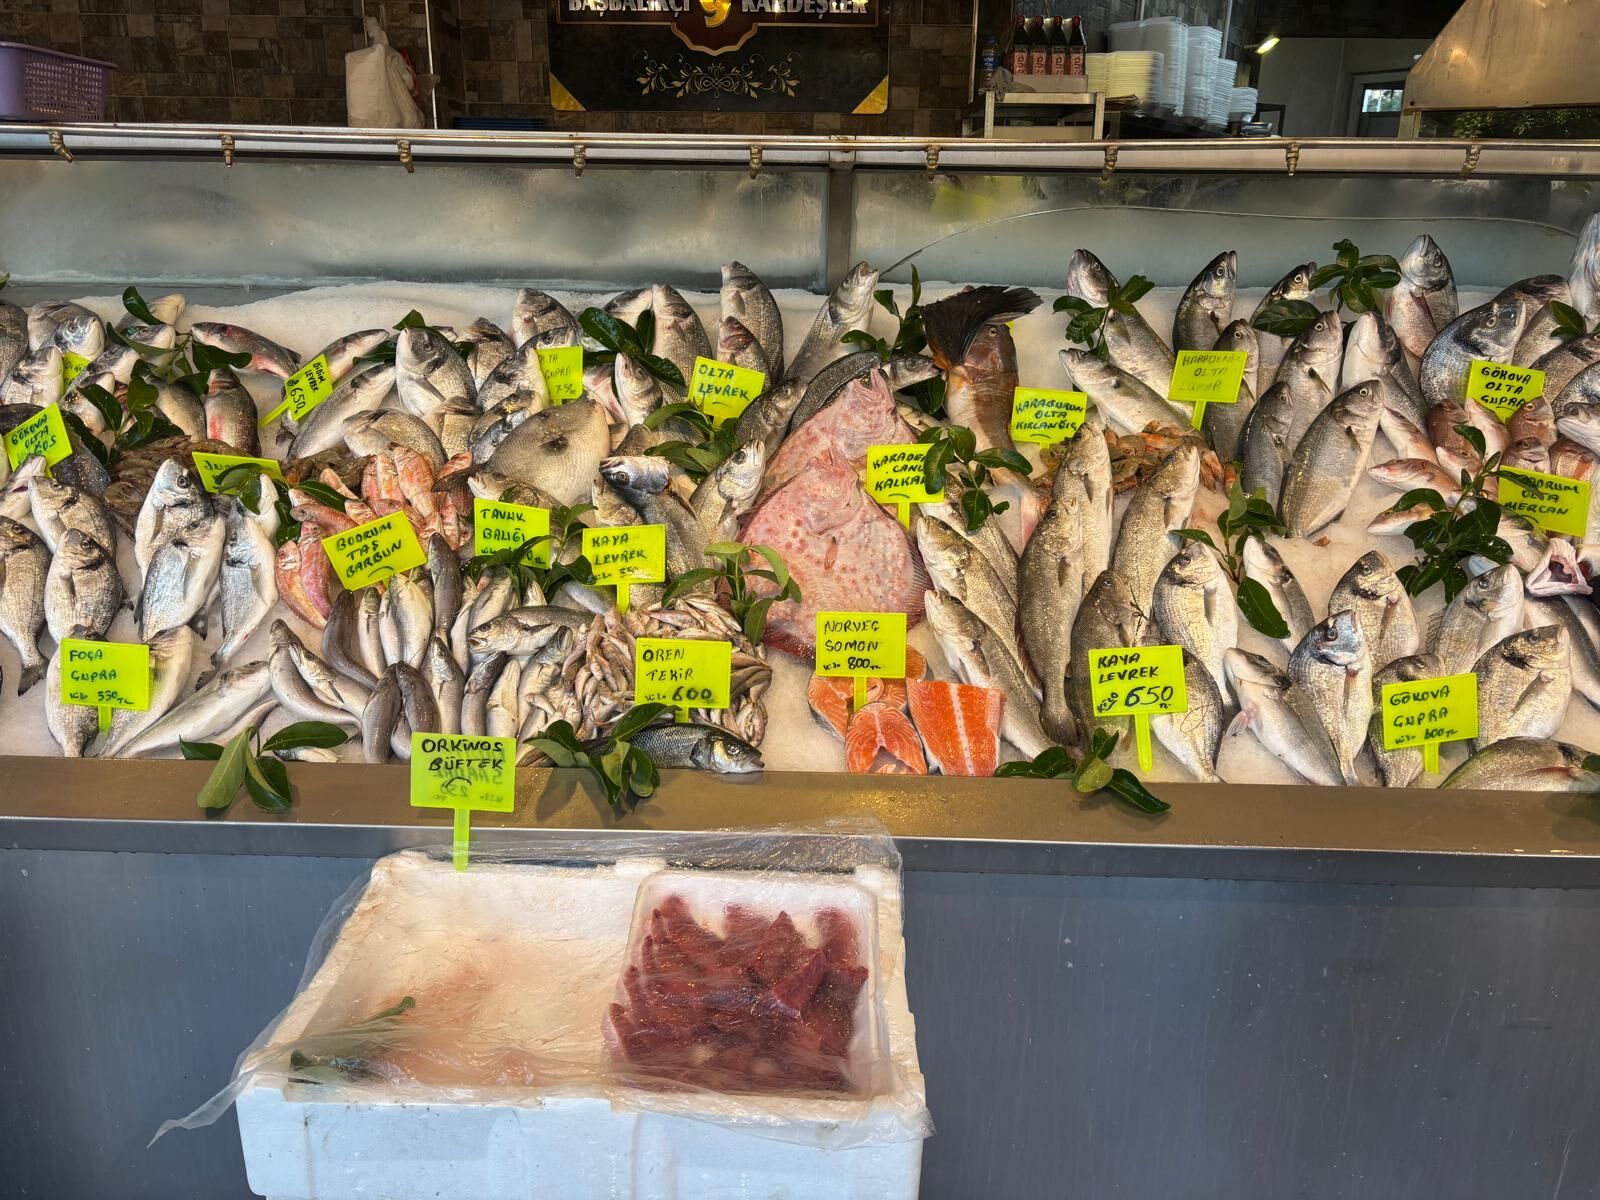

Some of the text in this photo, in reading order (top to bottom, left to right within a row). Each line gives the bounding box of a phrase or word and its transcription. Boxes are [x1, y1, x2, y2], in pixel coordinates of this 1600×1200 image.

[699, 364, 734, 379] OLTA
[1481, 366, 1532, 384] GÖKOVA
[698, 383, 750, 401] LEVREK
[1485, 382, 1524, 394] OLTA
[290, 387, 306, 410] 650
[1035, 410, 1067, 419] OLTA
[11, 414, 48, 445] GÖKOVA
[24, 425, 49, 449] OLTA
[892, 464, 925, 473] CANL
[480, 508, 526, 522] TAVUK
[1503, 501, 1568, 515] MERCAN
[336, 521, 392, 551] BODRUM
[482, 528, 525, 542] BALIĞI
[592, 533, 629, 548] KAYA
[346, 539, 402, 578] BARBUN
[594, 550, 648, 565] LEVREK
[825, 640, 878, 652] SOMON
[848, 656, 870, 669] 800
[1097, 652, 1140, 669] KAYA
[646, 667, 694, 682] TEKİR
[1098, 666, 1159, 684] LEVREK
[672, 686, 712, 701] 600
[1125, 686, 1174, 707] 650
[1390, 685, 1450, 706] GÖKOVA
[421, 738, 504, 753] ORKİNOS
[428, 756, 503, 771] BÜFTEK
